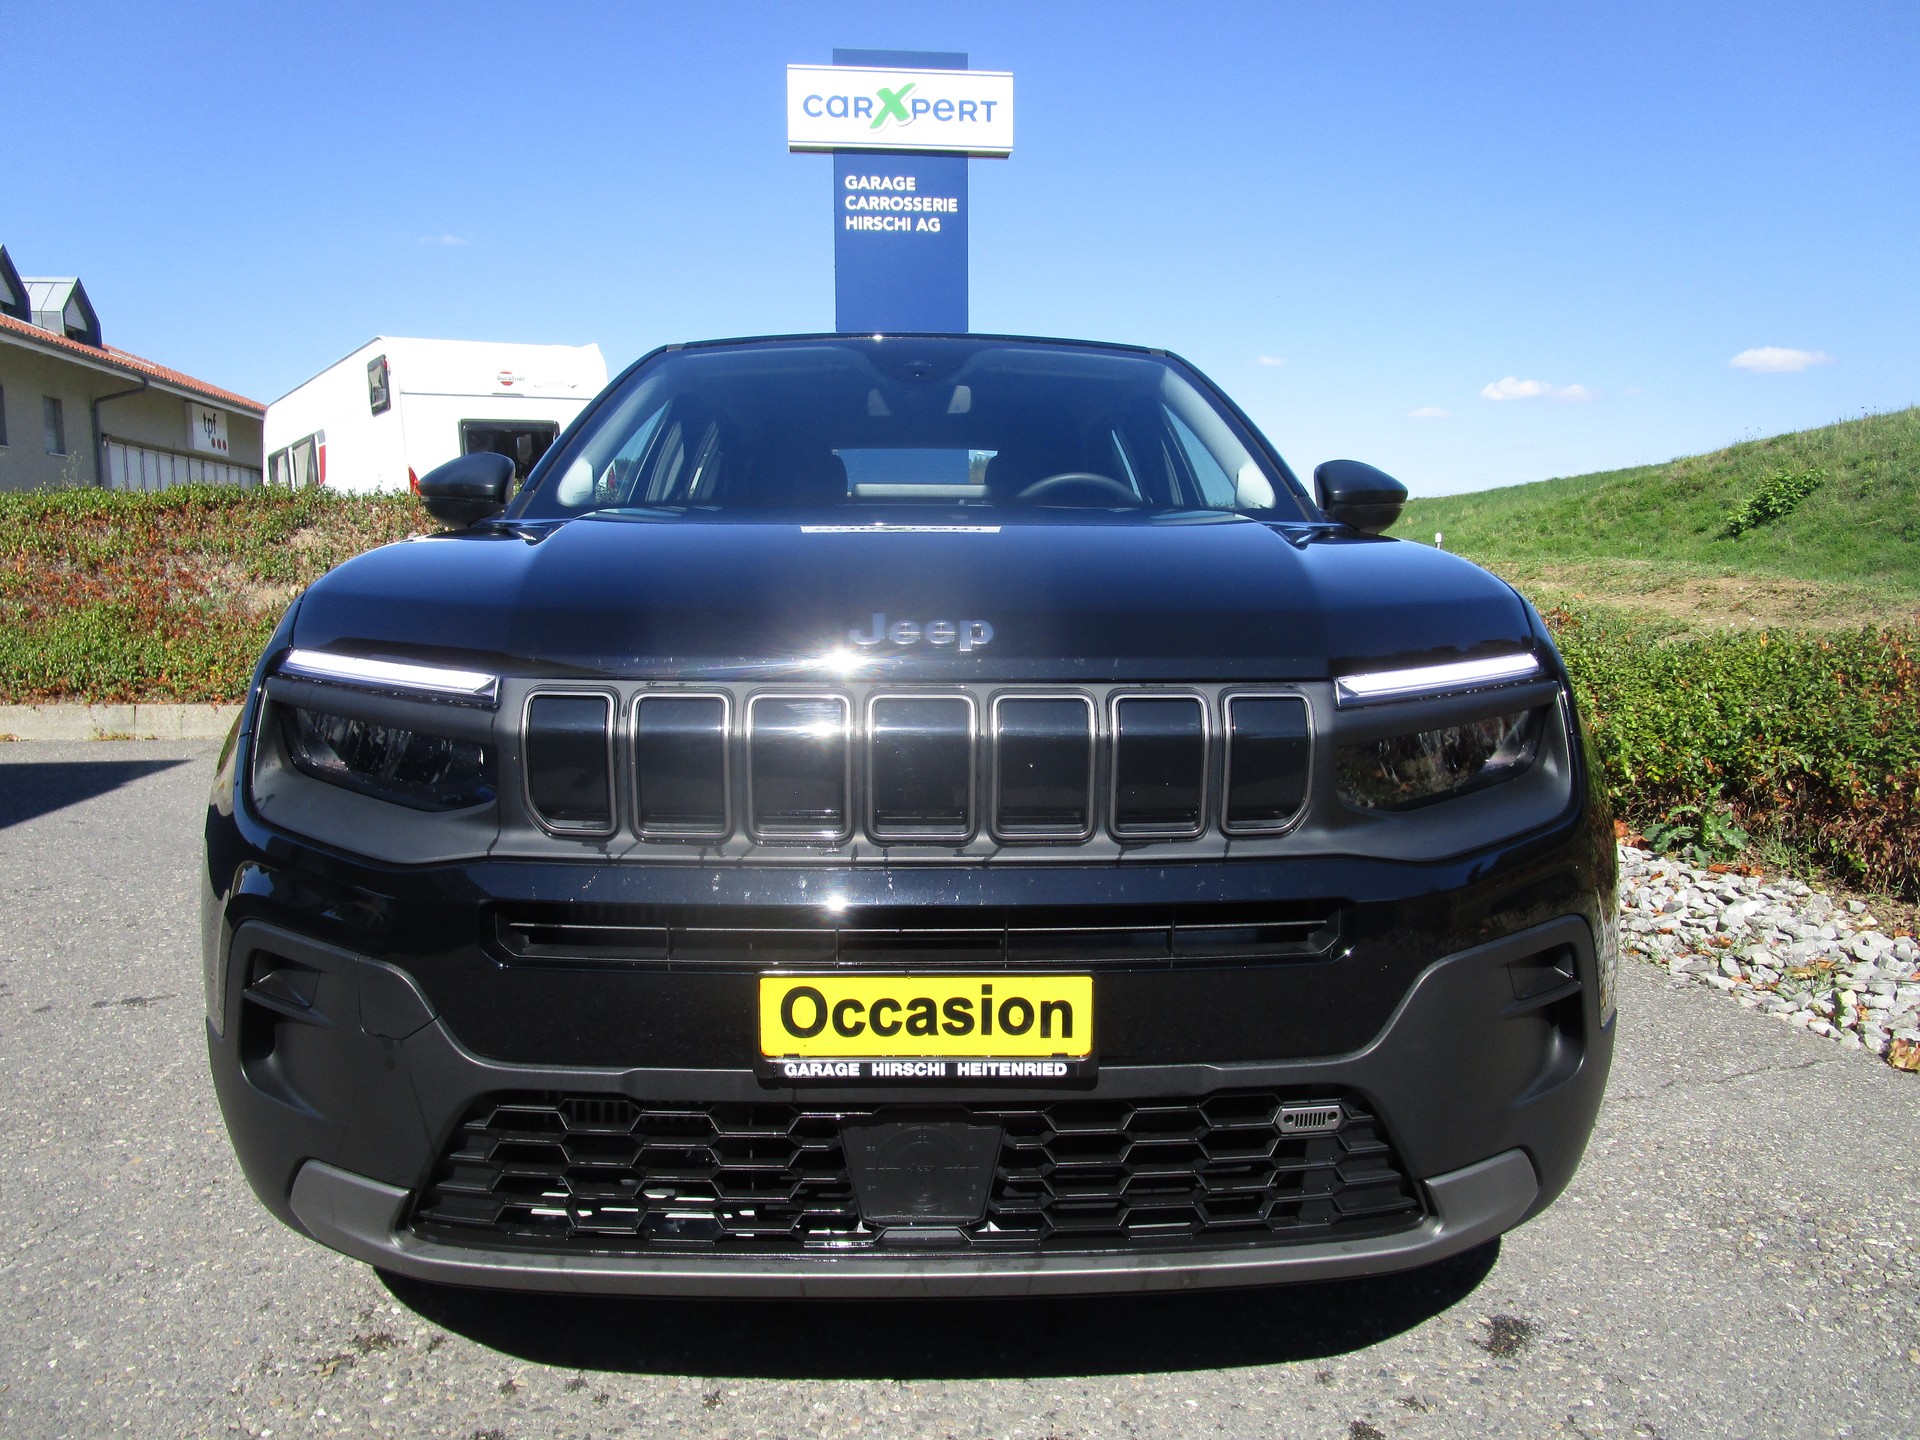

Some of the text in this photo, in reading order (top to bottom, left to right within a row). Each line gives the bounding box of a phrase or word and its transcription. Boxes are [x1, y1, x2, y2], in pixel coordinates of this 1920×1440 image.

[844, 175, 916, 191] GARAGE
[844, 196, 958, 213] CARROSSERIE
[845, 216, 941, 232] HIRSCHI AG
[202, 412, 217, 439] tpf
[849, 612, 994, 652] Jeep
[780, 984, 1073, 1039] Occasion
[784, 1063, 1068, 1077] GARAGE HIRSCHI HEITENRIED
